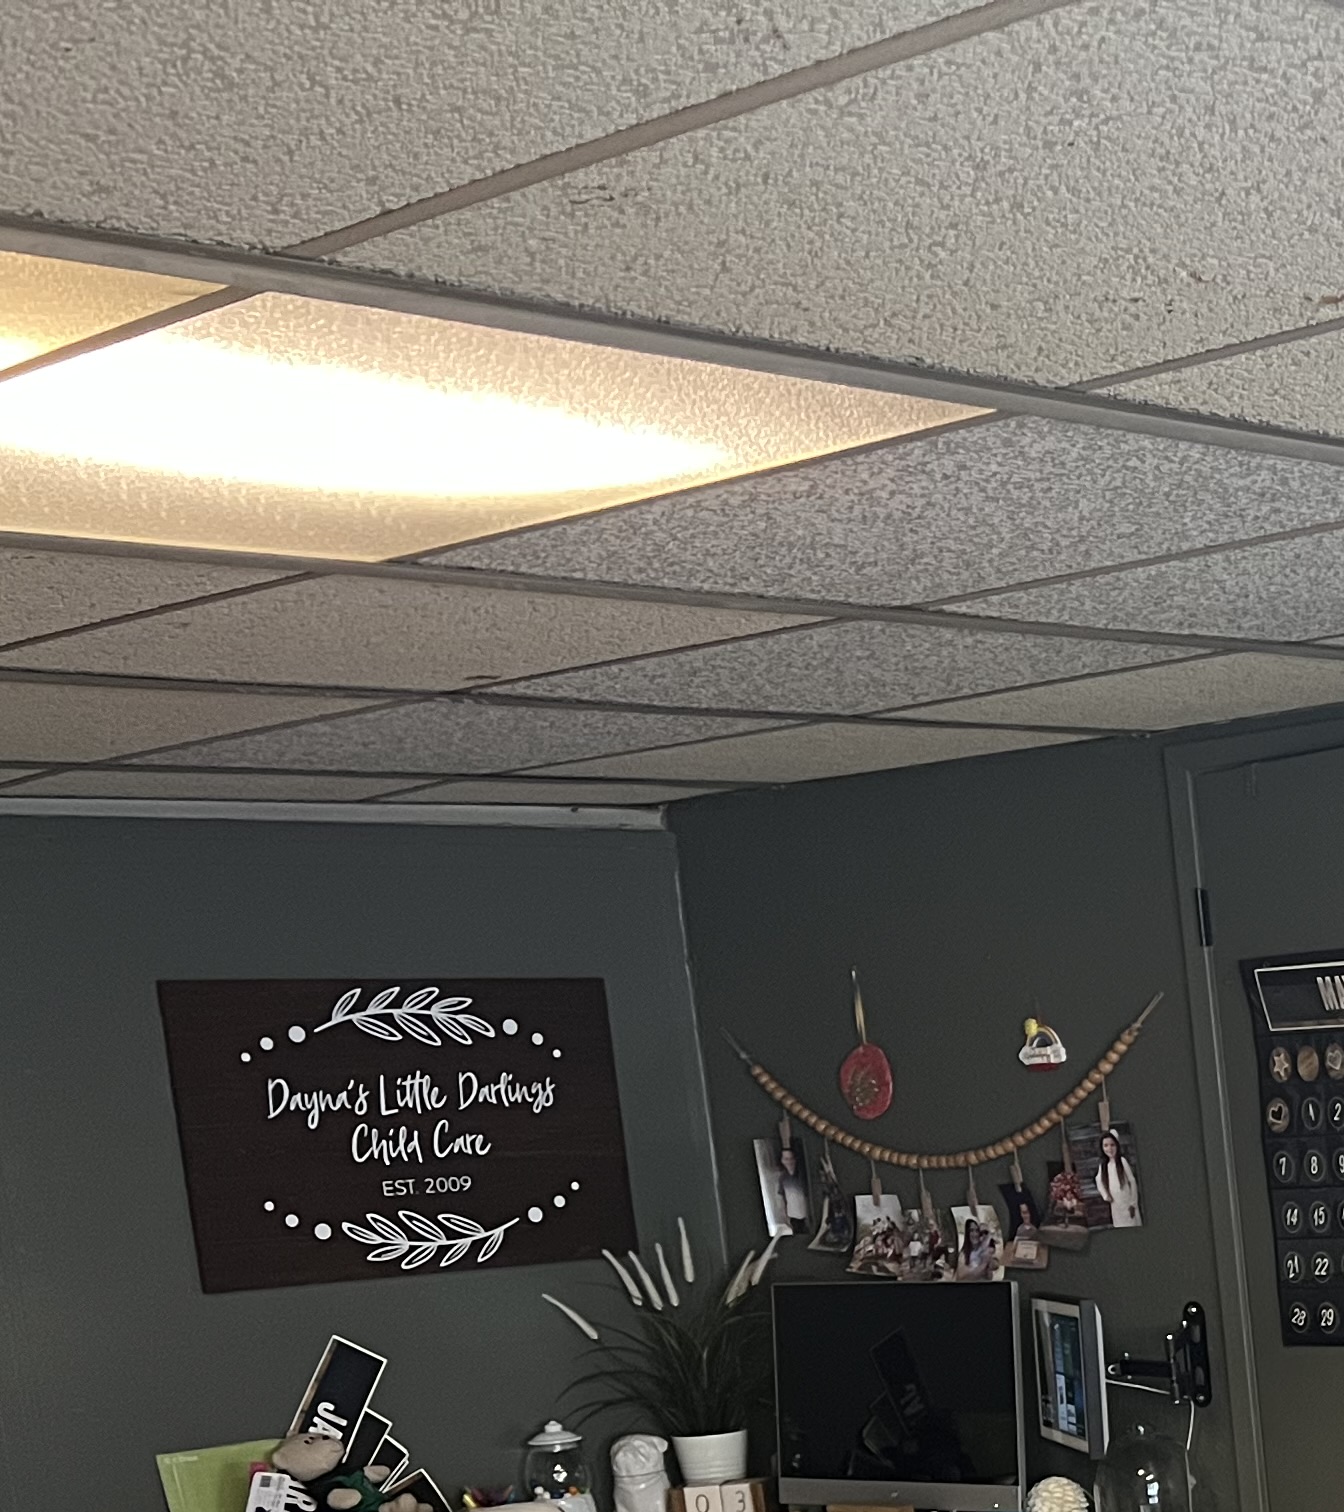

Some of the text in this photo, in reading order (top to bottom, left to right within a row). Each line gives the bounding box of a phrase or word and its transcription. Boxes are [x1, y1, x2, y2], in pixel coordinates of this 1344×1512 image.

[268, 1070, 555, 1129] Dayna's Little Darlings
[351, 1120, 492, 1165] Child Care
[382, 1176, 471, 1196] EST. 2009
[1286, 1208, 1298, 1225] 14
[1313, 1206, 1325, 1227] 15
[1287, 1256, 1299, 1278] 21
[1314, 1258, 1329, 1276] 22
[1291, 1308, 1306, 1326] 28
[1321, 1309, 1334, 1327] 29
